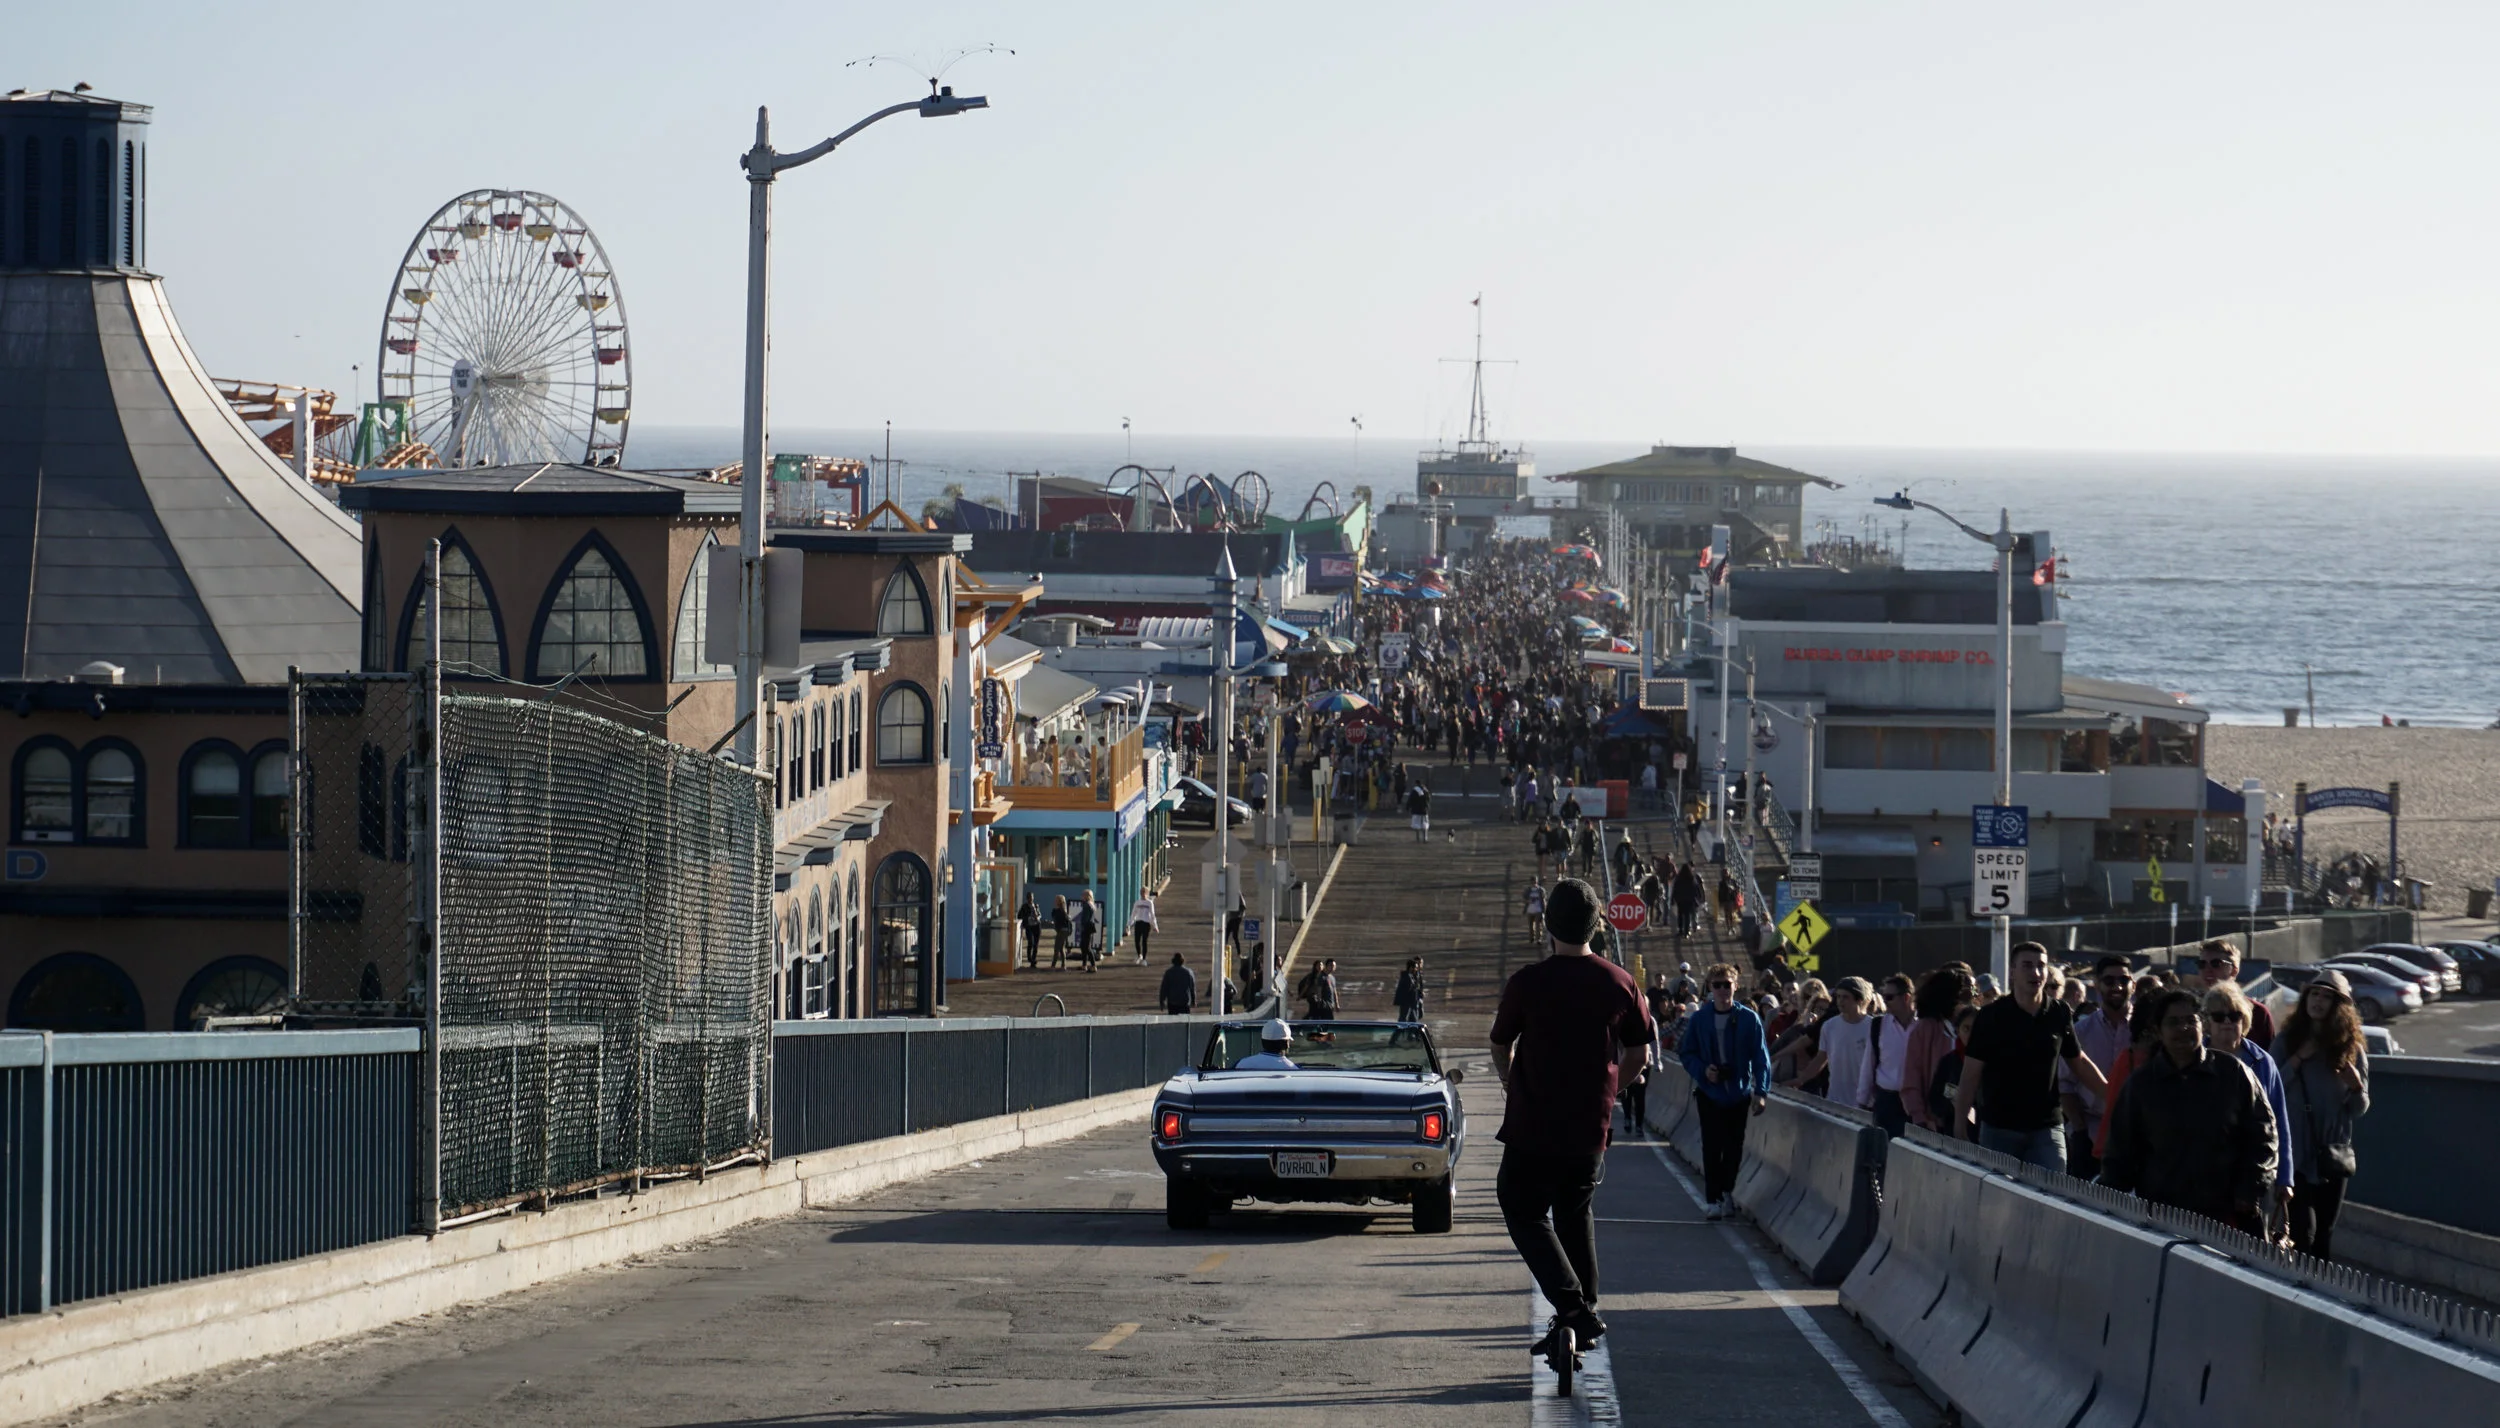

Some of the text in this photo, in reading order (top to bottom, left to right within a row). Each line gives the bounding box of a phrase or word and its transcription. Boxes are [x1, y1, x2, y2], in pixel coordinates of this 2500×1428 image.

[1785, 647, 1994, 664] BUBBA GUMP SHRIMP CO.
[986, 681, 994, 744] SEASIDE
[1347, 727, 1365, 738] STOP
[5, 848, 48, 881] D
[1977, 854, 2024, 865] SPEED
[1981, 870, 2019, 880] LIMIT
[1991, 885, 2010, 909] 5
[1610, 904, 1643, 919] STOP
